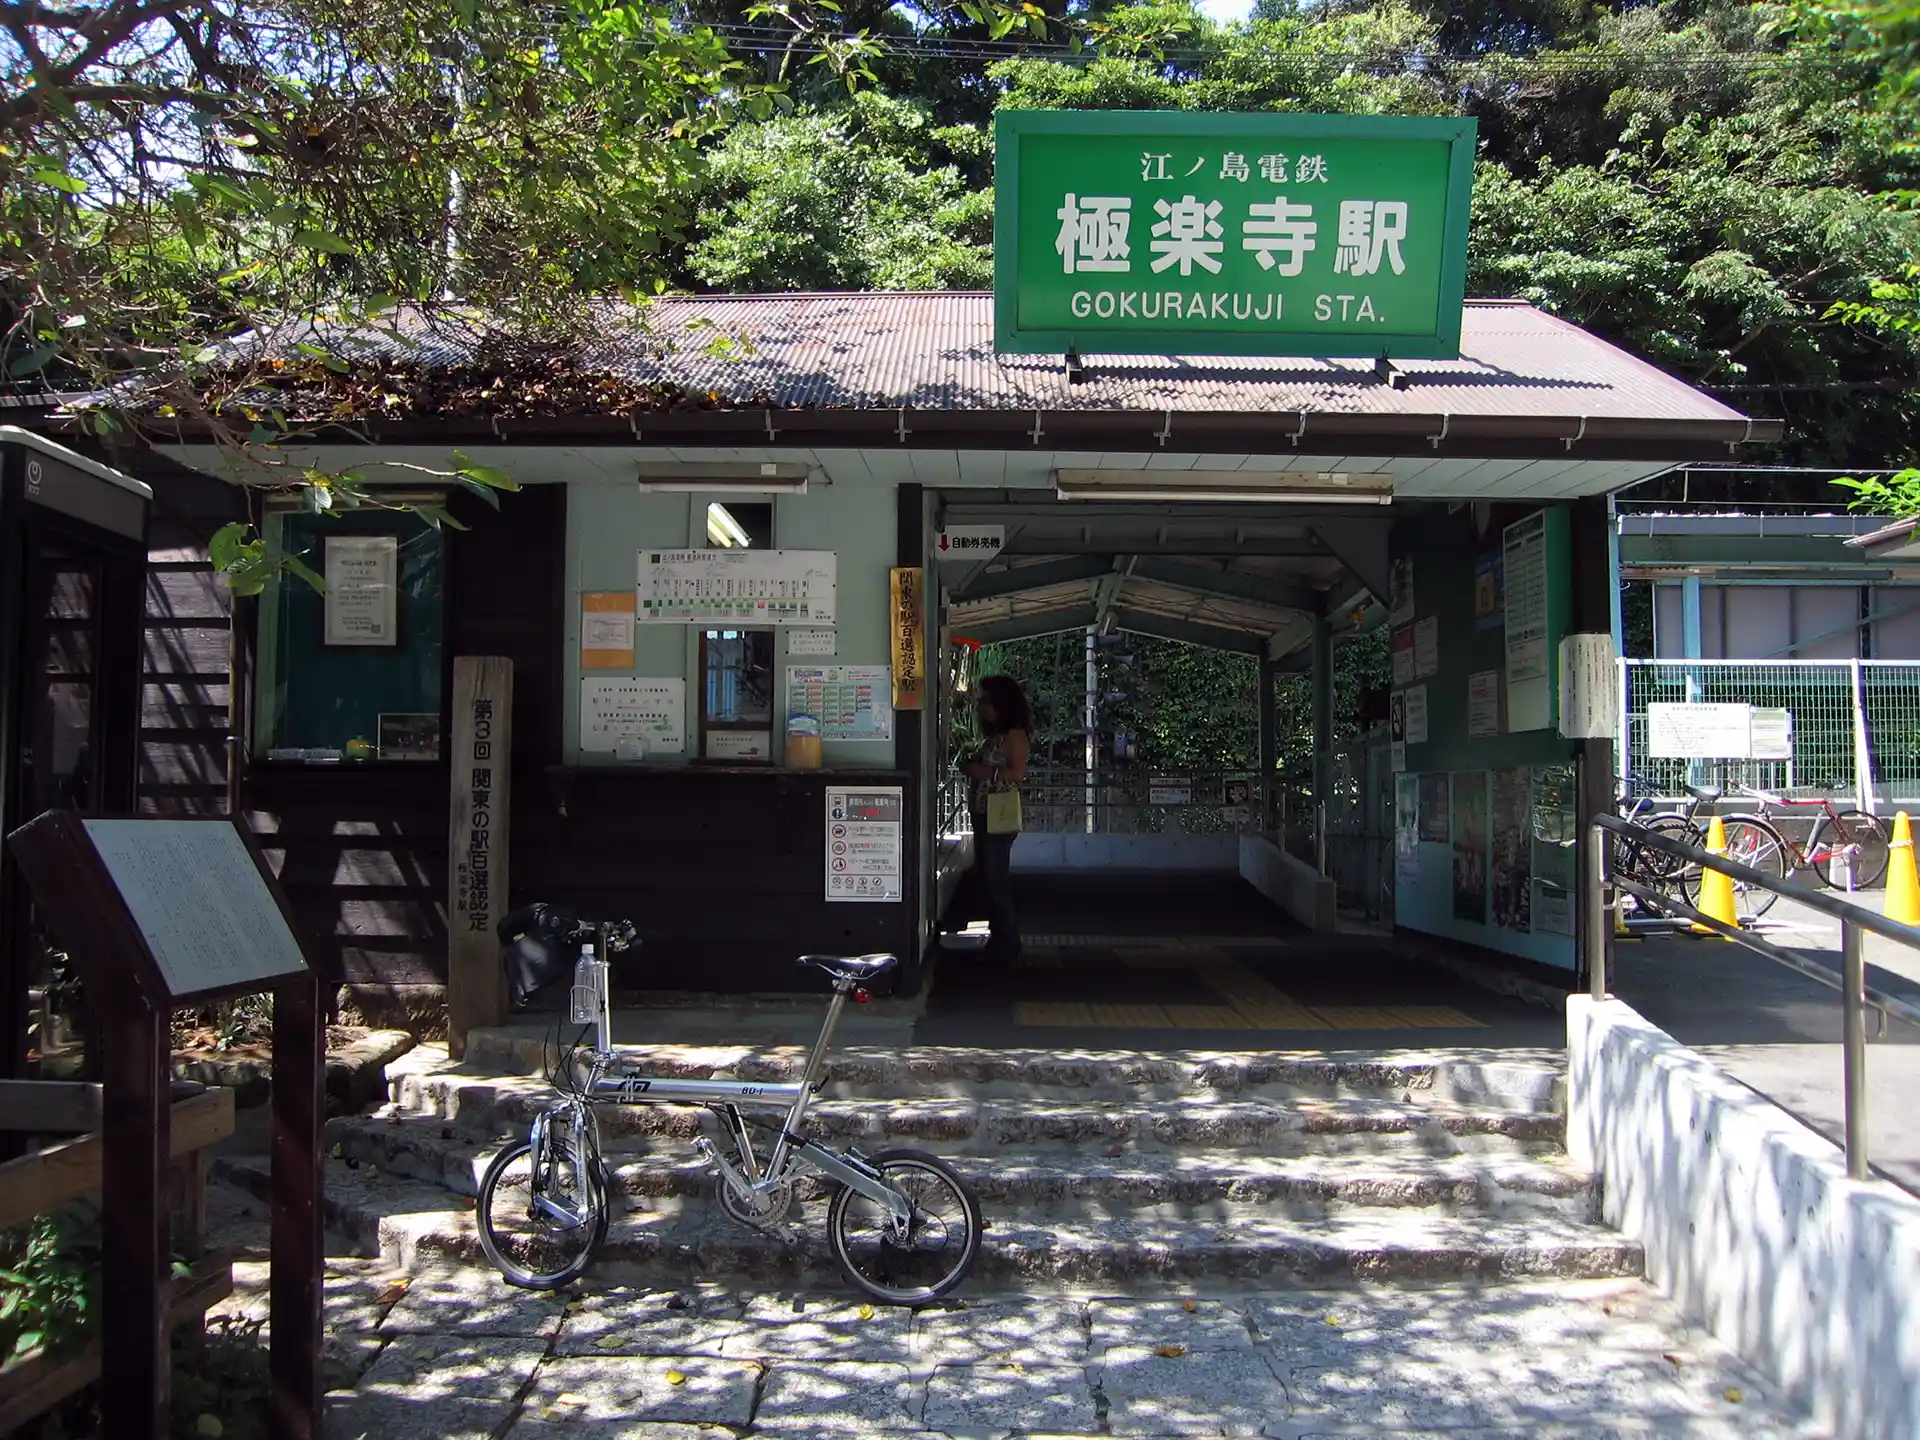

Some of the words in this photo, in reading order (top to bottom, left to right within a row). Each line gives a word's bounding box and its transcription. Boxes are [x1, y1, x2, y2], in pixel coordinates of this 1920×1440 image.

[1140, 152, 1329, 183] 江ノ島電鉄
[1055, 193, 1407, 277] 極楽寺駅
[1071, 291, 1283, 320] GOKURAKUJI
[1314, 294, 1386, 323] STA.
[952, 537, 1000, 549] 自動券売機
